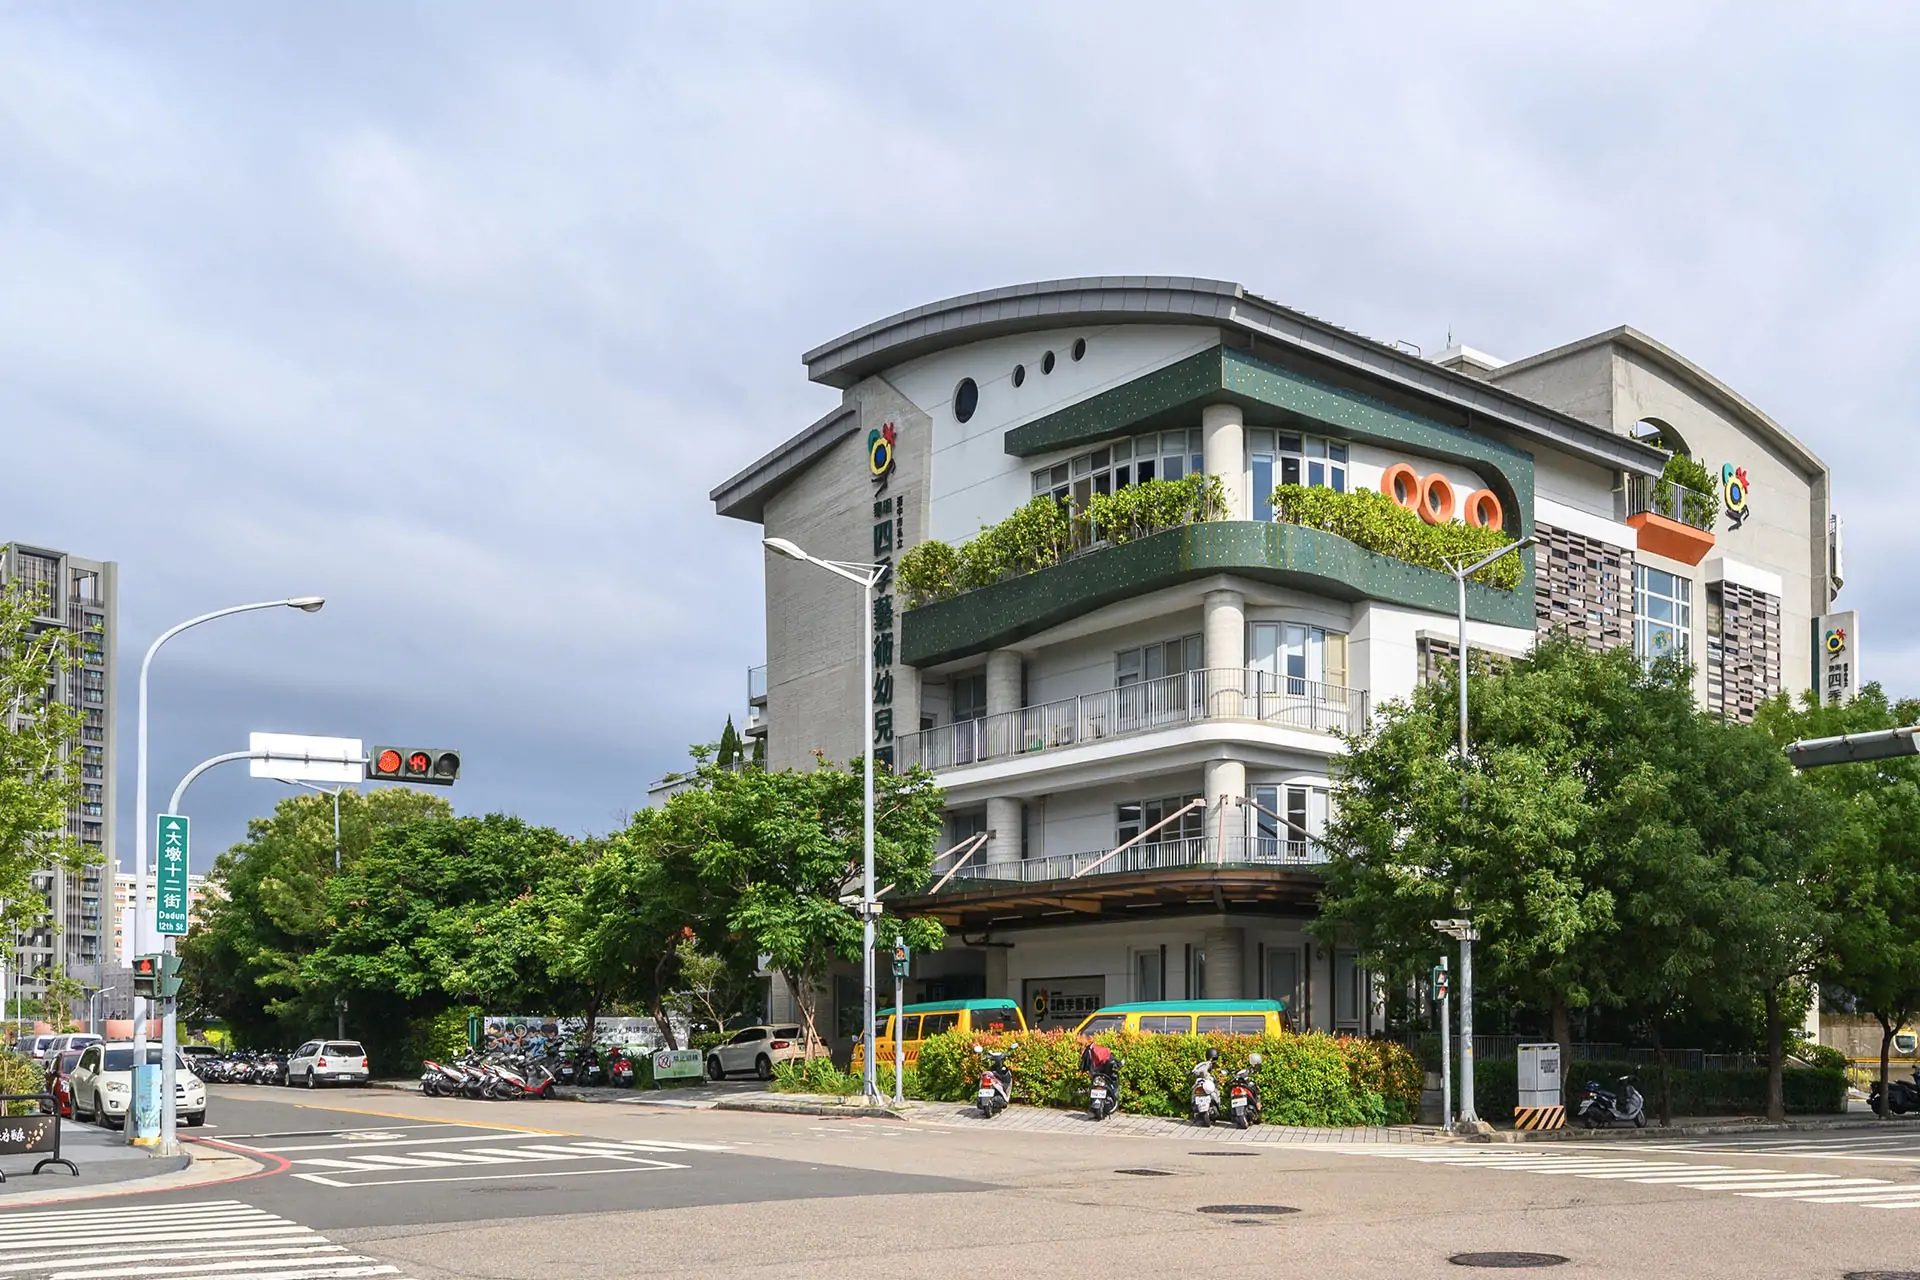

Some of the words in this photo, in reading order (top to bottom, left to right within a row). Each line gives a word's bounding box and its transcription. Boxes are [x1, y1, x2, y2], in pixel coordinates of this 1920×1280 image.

[164, 831, 182, 909] 大墩十二街
[159, 910, 185, 920] Dadun
[159, 922, 174, 931] 12th
[175, 923, 184, 931] St
